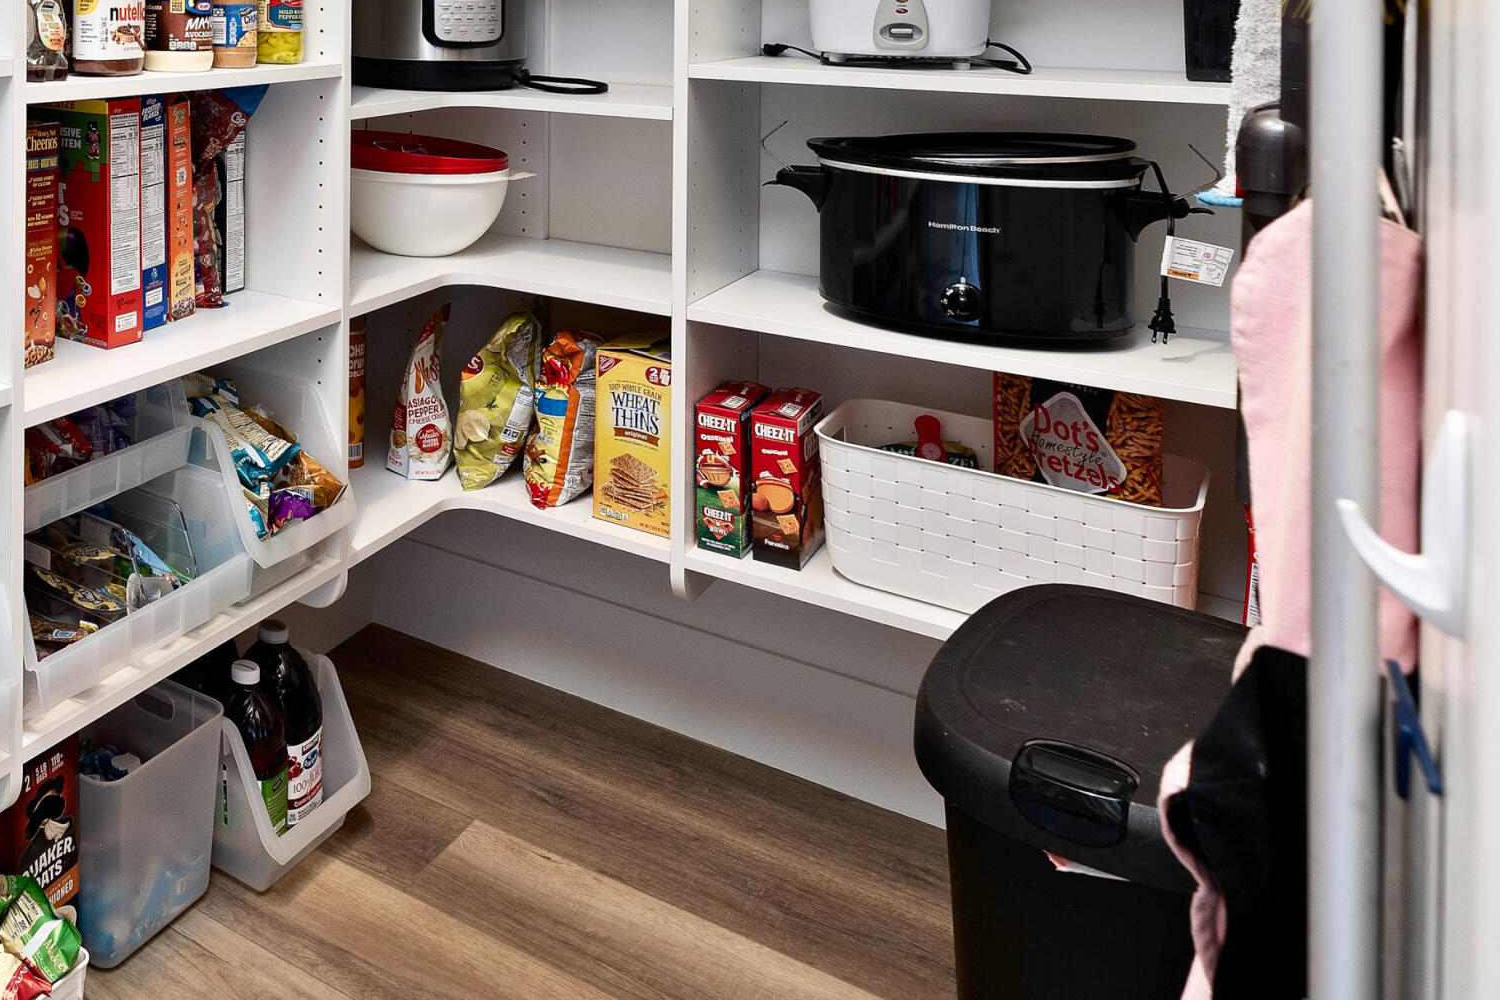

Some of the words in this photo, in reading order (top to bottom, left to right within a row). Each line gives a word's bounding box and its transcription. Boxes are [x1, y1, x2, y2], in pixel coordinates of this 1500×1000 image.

[55, 100, 76, 110] SIZE
[26, 137, 58, 152] Cheerios
[61, 139, 81, 150] ITEM
[928, 221, 970, 232] Hamilton
[970, 225, 1000, 234] Beach
[650, 367, 658, 377] 2
[622, 385, 642, 395] WHOLE
[642, 388, 662, 402] GRAIN
[408, 395, 437, 410] ASIAGO
[610, 391, 661, 415] WHEAT
[408, 404, 439, 419] PEPPER
[408, 416, 431, 425] CHEESE
[1034, 403, 1100, 453] Dot's
[624, 430, 648, 441] original
[1031, 428, 1104, 467] Homestyle
[1028, 437, 1123, 495] Pretzels
[709, 525, 728, 536] BOWL
[764, 538, 790, 551] Fanatics
[51, 752, 64, 768] 110+
[40, 762, 48, 774] LB
[24, 774, 31, 793] 2
[36, 772, 48, 785] BAGS
[49, 878, 74, 906] HIONED
